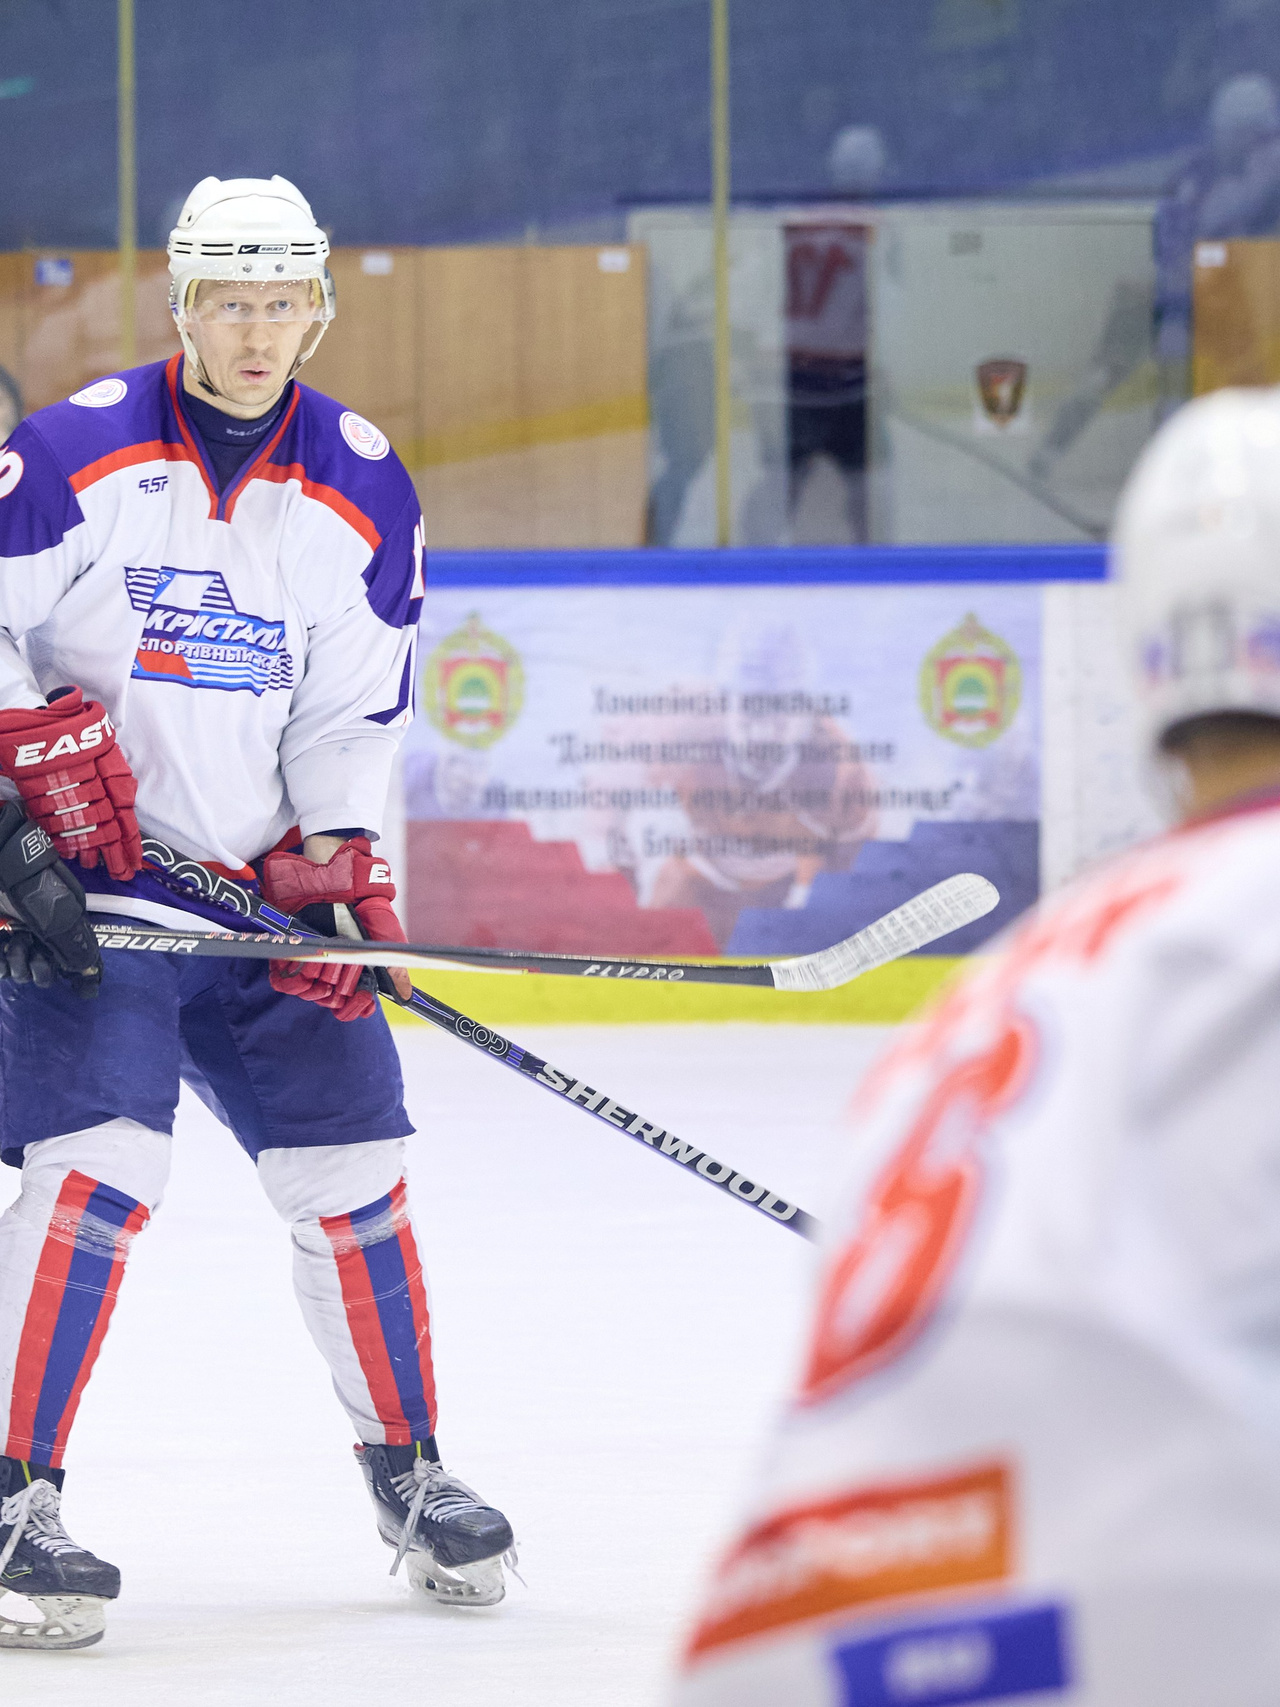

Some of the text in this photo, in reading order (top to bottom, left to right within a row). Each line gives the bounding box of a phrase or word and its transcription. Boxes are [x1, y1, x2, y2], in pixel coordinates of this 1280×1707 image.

[144, 608, 288, 651] КРИСТАЛ
[583, 964, 684, 981] FLYPRO
[535, 1062, 798, 1221] SHERWOOD
